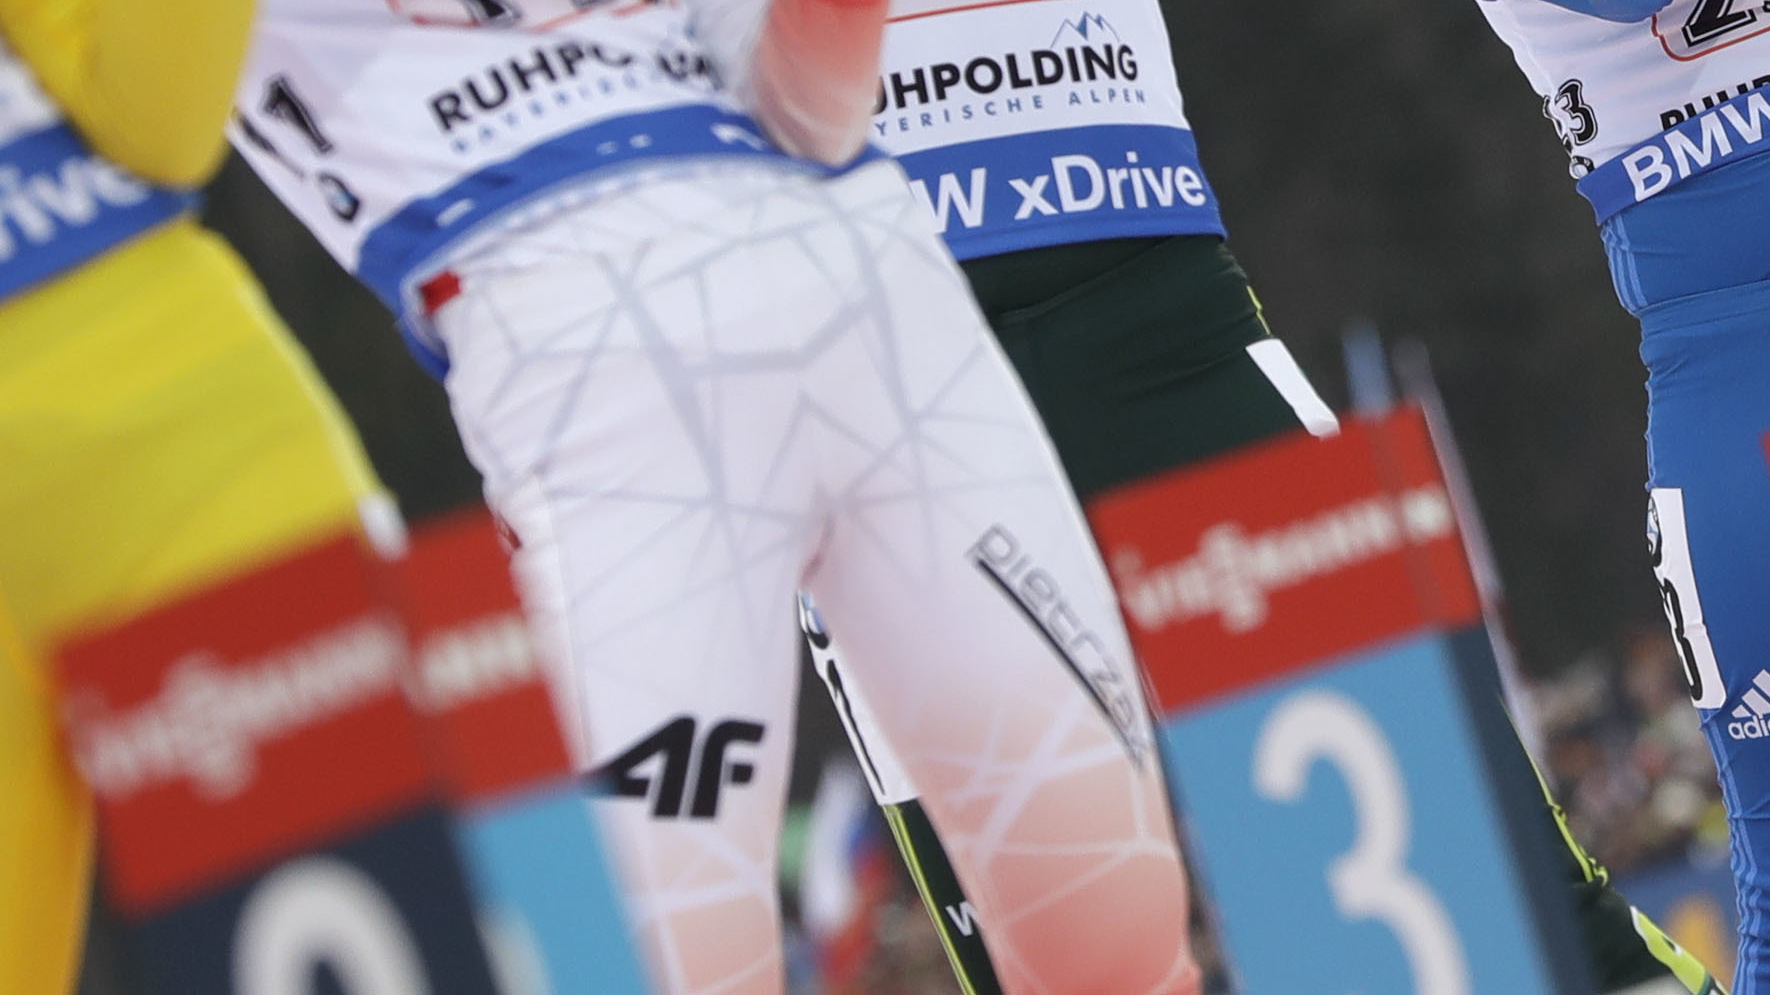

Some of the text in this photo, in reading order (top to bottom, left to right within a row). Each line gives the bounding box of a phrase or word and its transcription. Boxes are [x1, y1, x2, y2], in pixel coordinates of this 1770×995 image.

[873, 87, 1146, 136] YERISCHE ALPEN
[1543, 77, 1598, 147] 3
[1008, 151, 1207, 222] xDrive
[1252, 686, 1473, 995] 3
